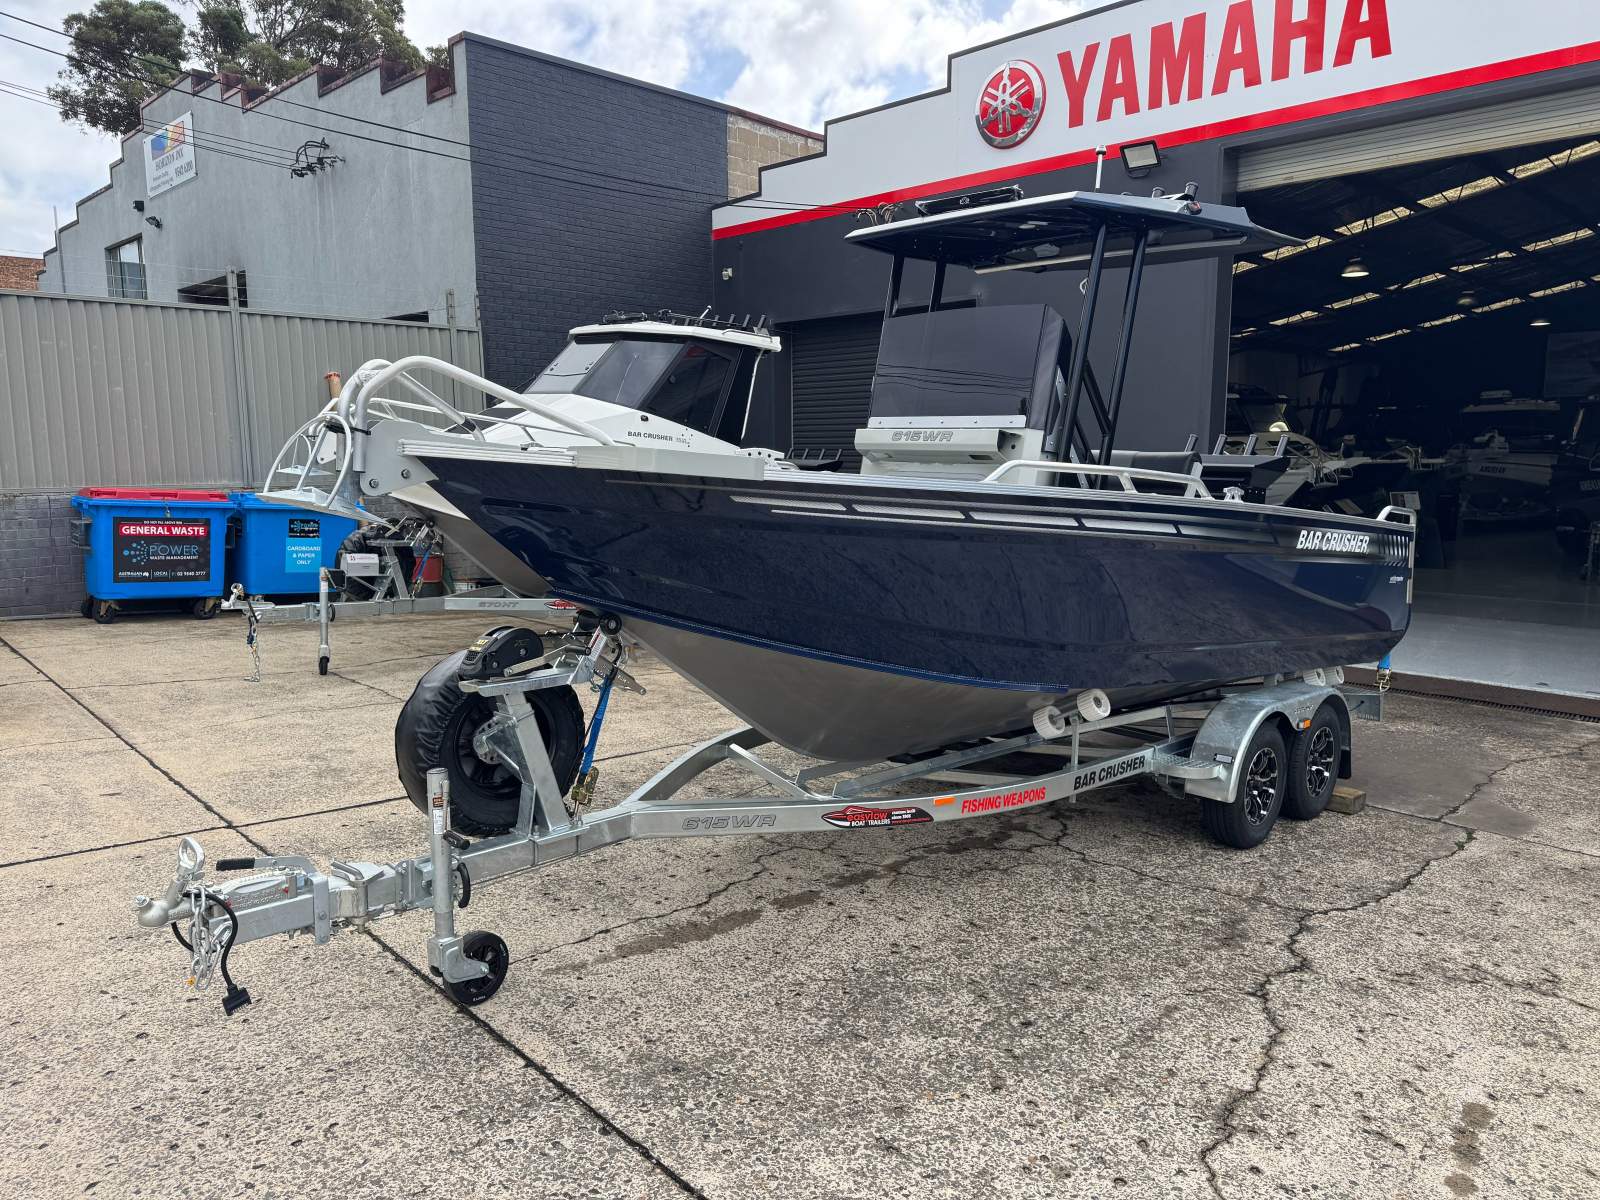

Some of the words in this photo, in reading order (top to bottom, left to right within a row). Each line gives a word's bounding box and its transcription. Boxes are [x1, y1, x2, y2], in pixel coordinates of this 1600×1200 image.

[1057, 0, 1392, 129] YAMAHA
[643, 432, 673, 442] CRUSHER
[891, 430, 954, 442] 615WR
[121, 525, 170, 535] GENERAL
[171, 526, 205, 536] WASTE
[1296, 529, 1321, 550] BAR
[1321, 532, 1370, 553] CRUSHER
[149, 544, 199, 556] POWER
[1073, 771, 1097, 791] BAR
[1098, 755, 1146, 782] CRUSHER
[961, 796, 1001, 814] FISHING
[1003, 787, 1046, 808] WEAPONS
[681, 814, 777, 831] 615WR
[867, 818, 891, 826] TRAILERS
